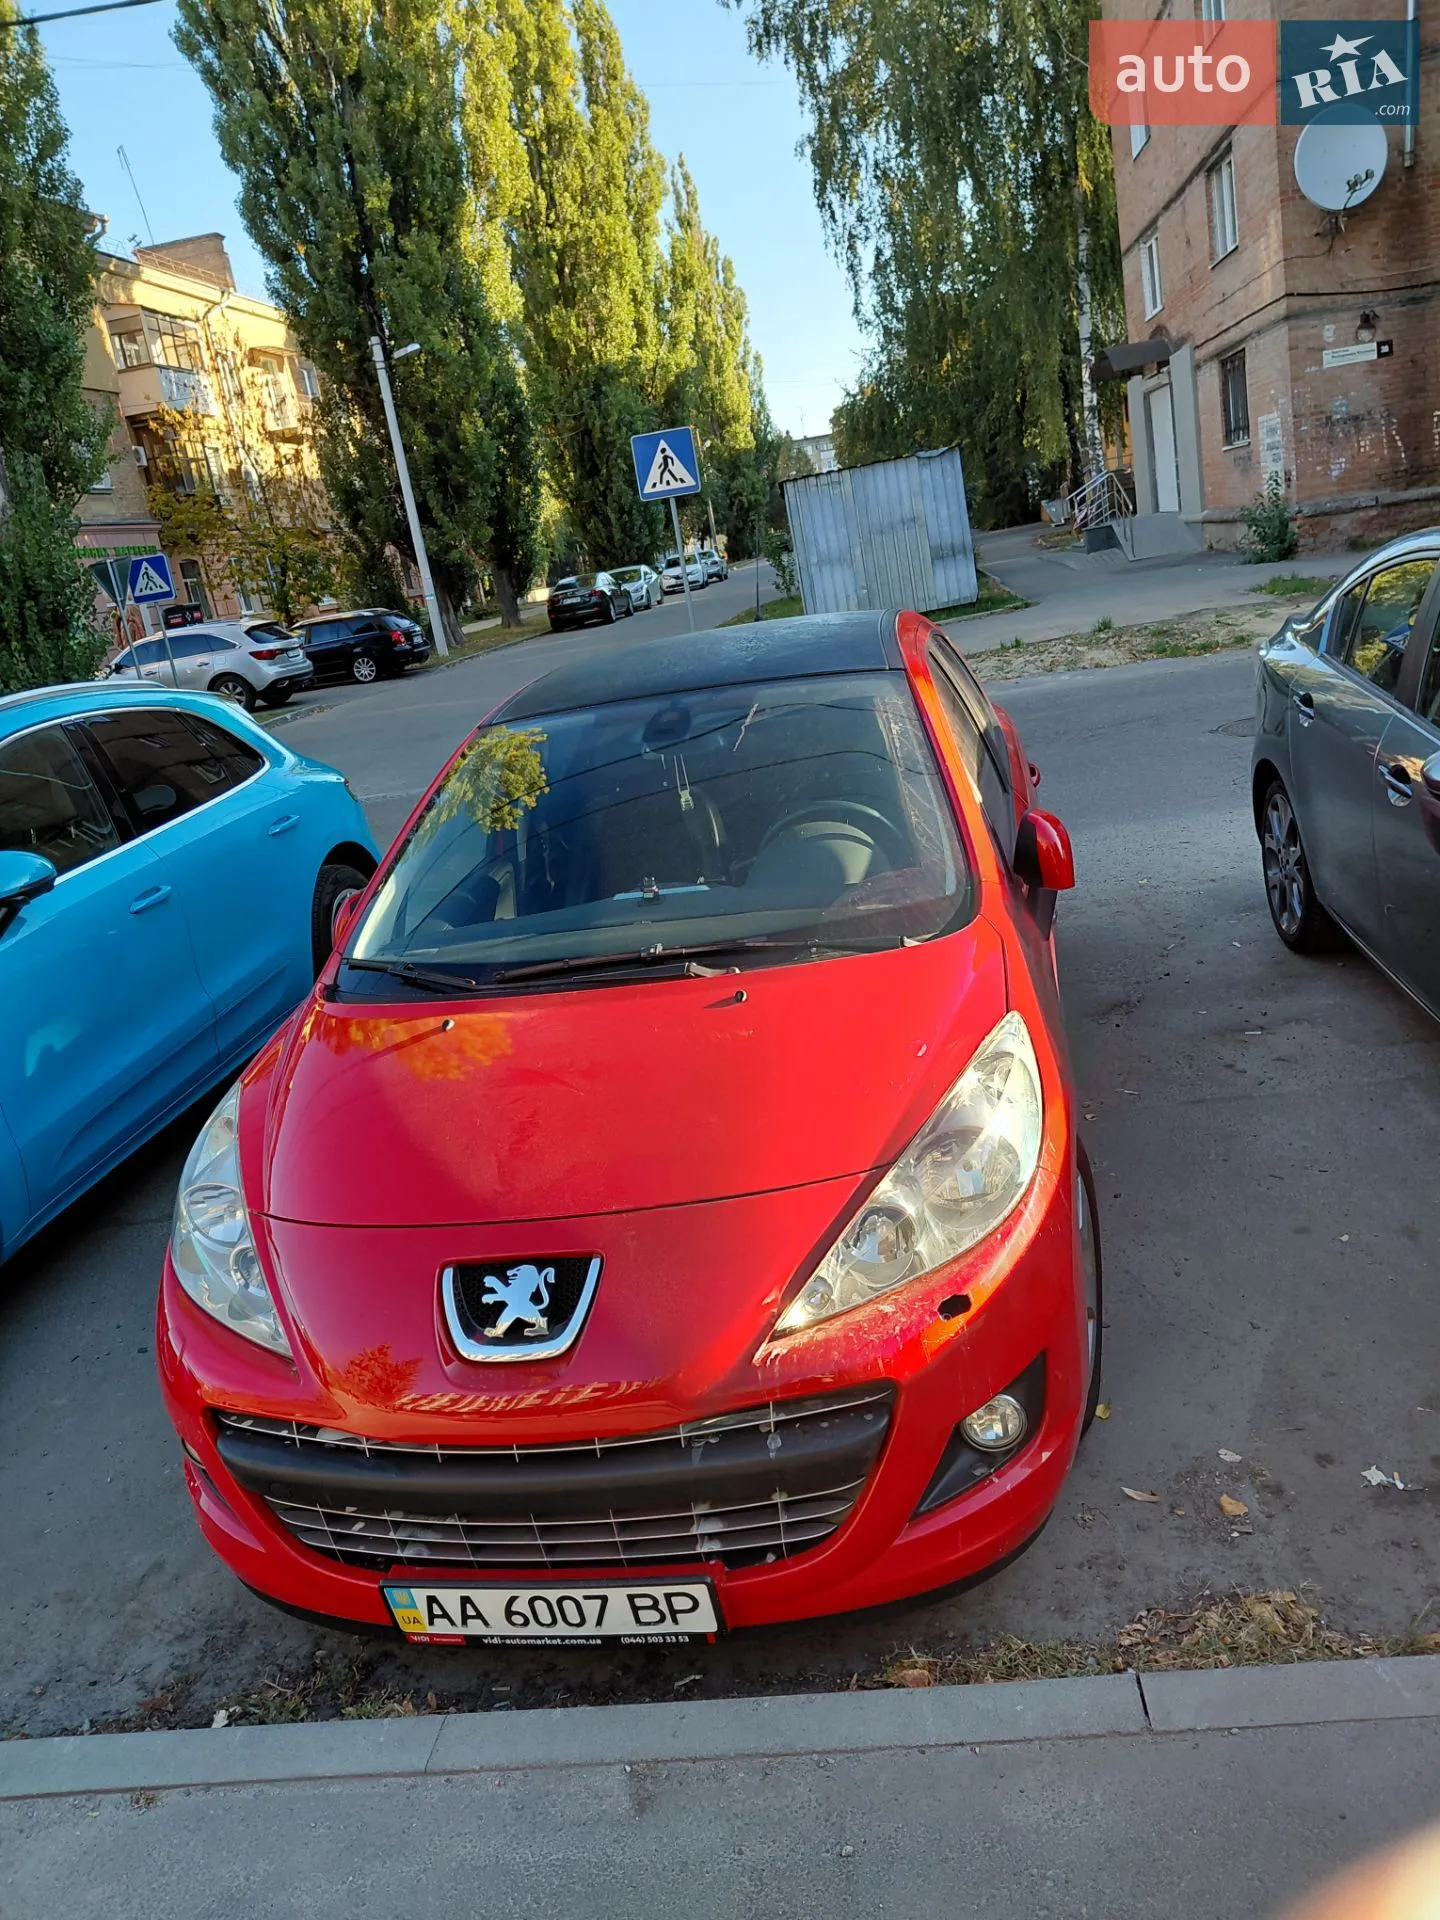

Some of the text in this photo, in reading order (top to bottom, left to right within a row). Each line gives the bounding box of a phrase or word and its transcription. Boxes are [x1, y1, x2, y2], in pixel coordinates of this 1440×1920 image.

[426, 1592, 700, 1629] AA 6007 BP
[402, 1615, 422, 1625] UA
[620, 1636, 646, 1645] (044)
